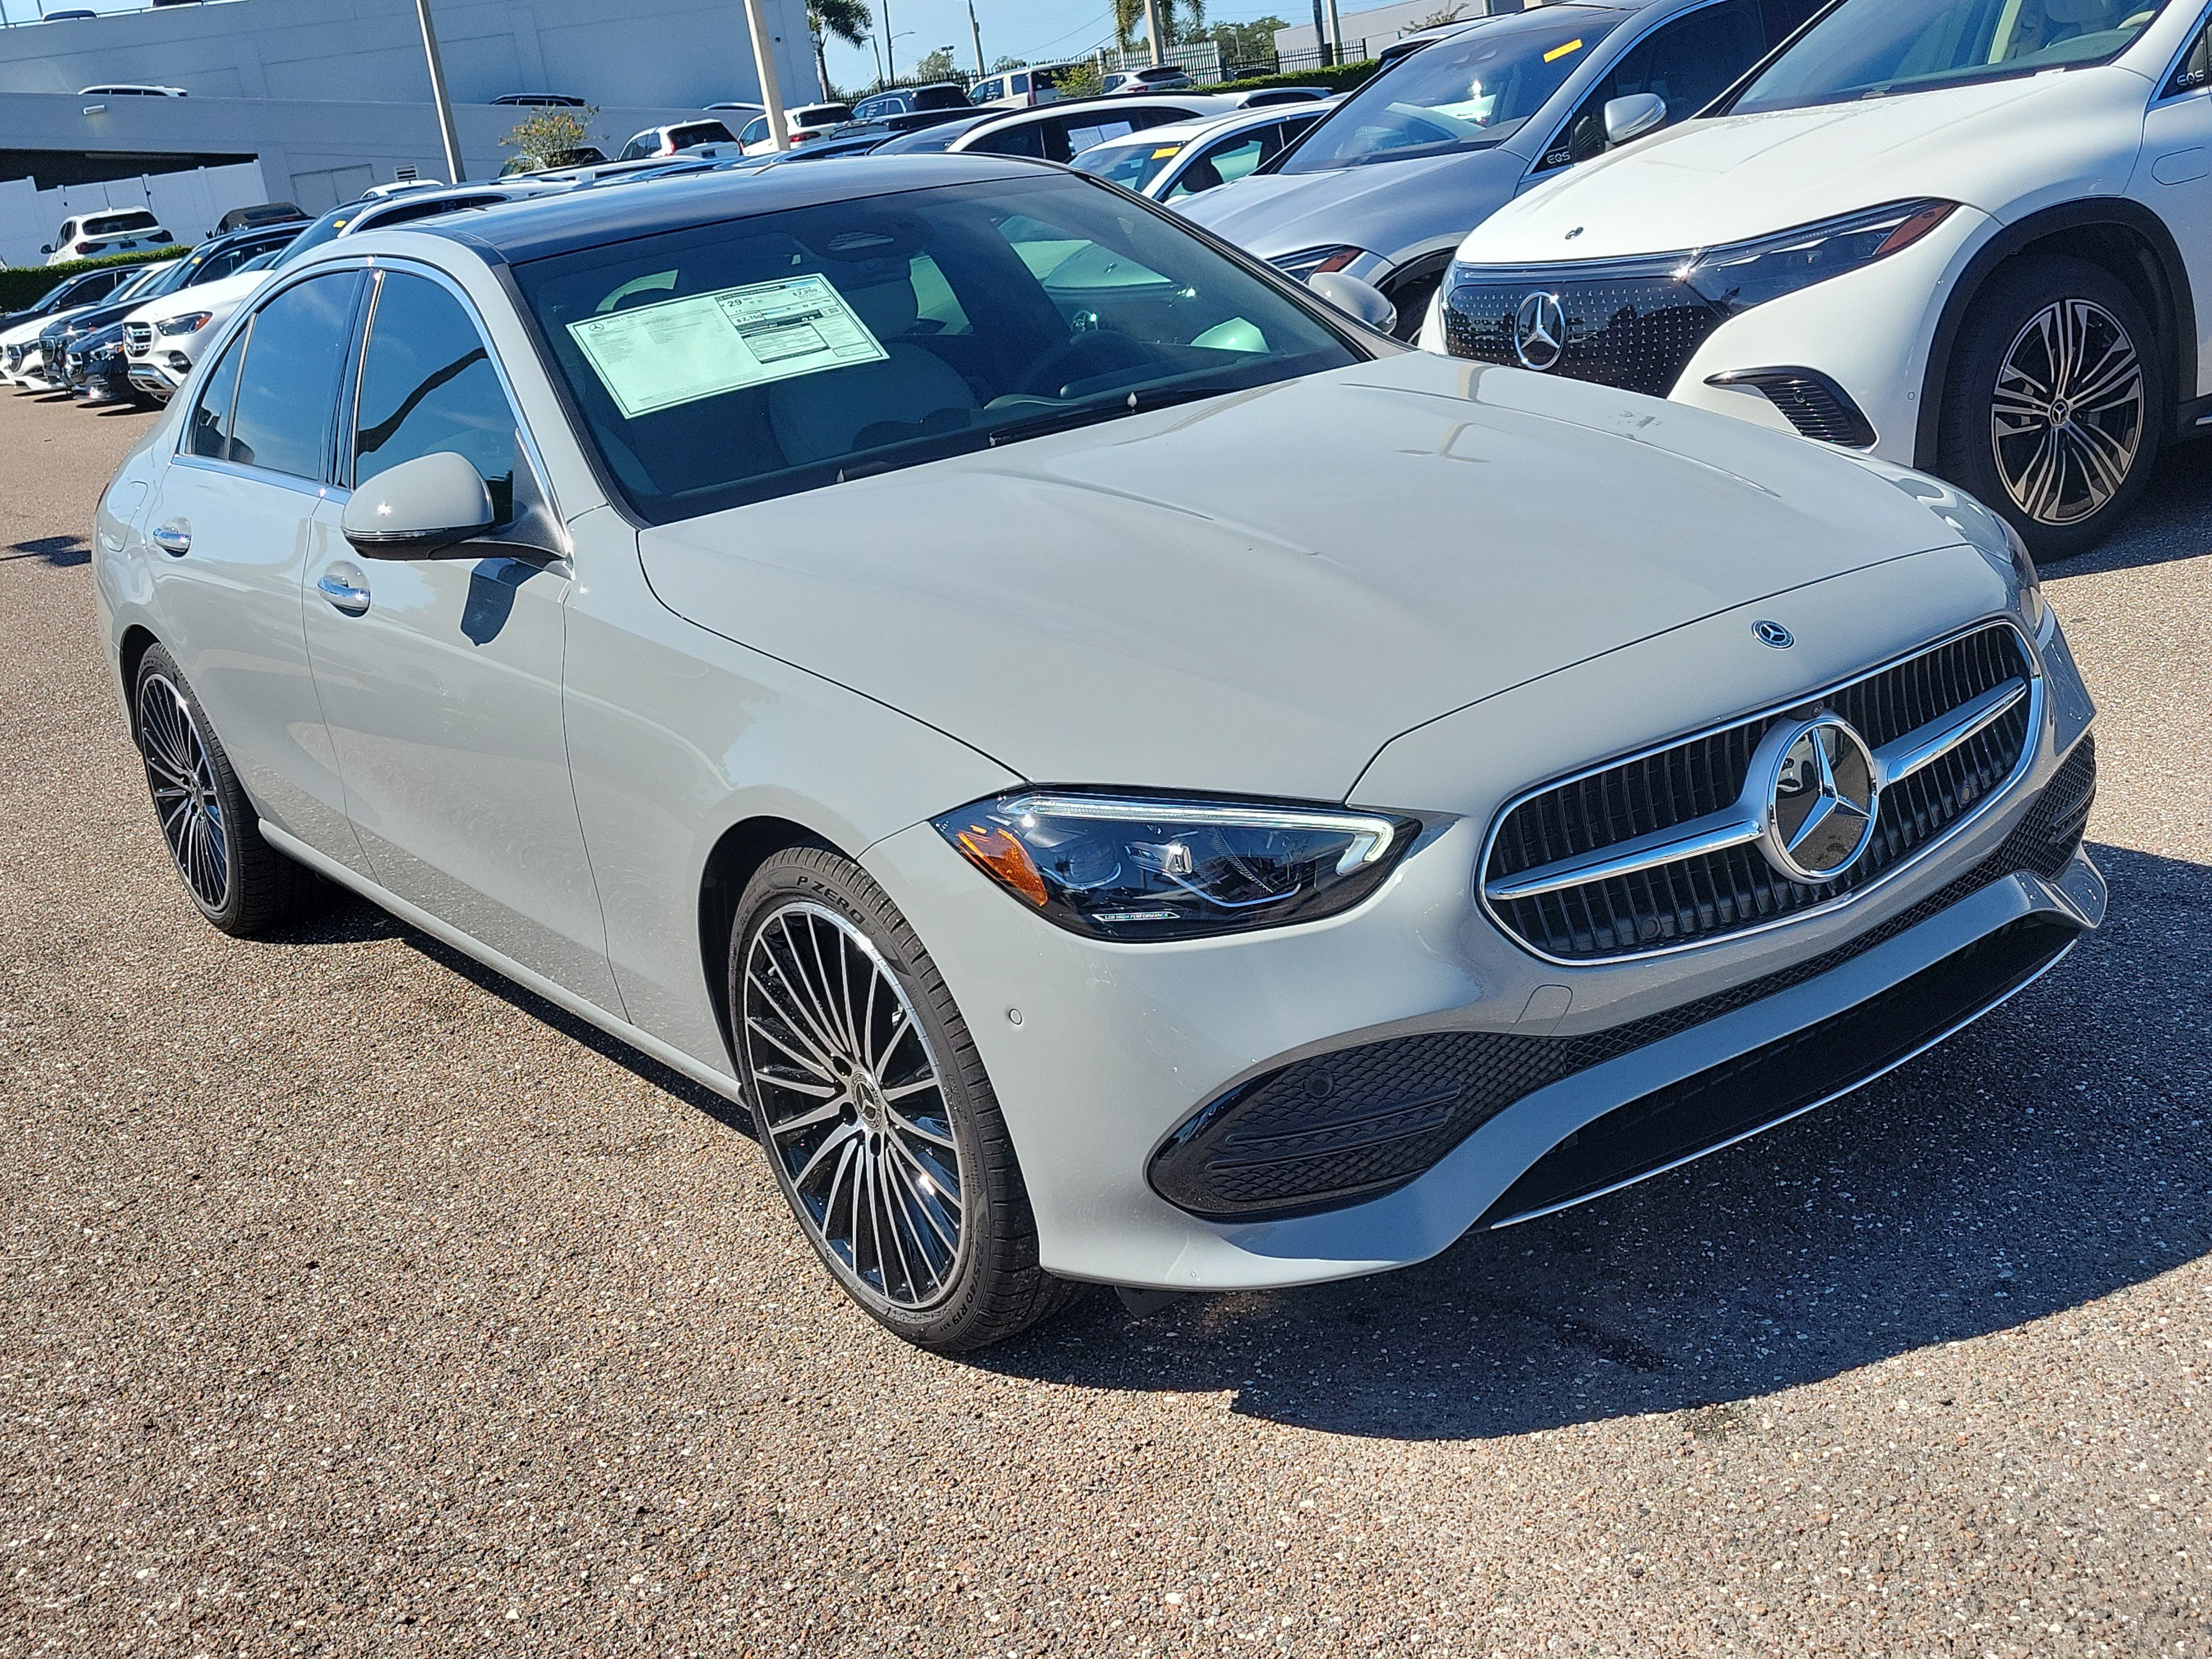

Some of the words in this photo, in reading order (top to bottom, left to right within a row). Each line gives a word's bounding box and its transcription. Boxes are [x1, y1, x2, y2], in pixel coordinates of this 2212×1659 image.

[2176, 69, 2204, 86] EQS
[1547, 151, 1571, 165] EQS
[727, 299, 742, 307] 29
[796, 876, 809, 886] P
[811, 880, 866, 925] ZERO
